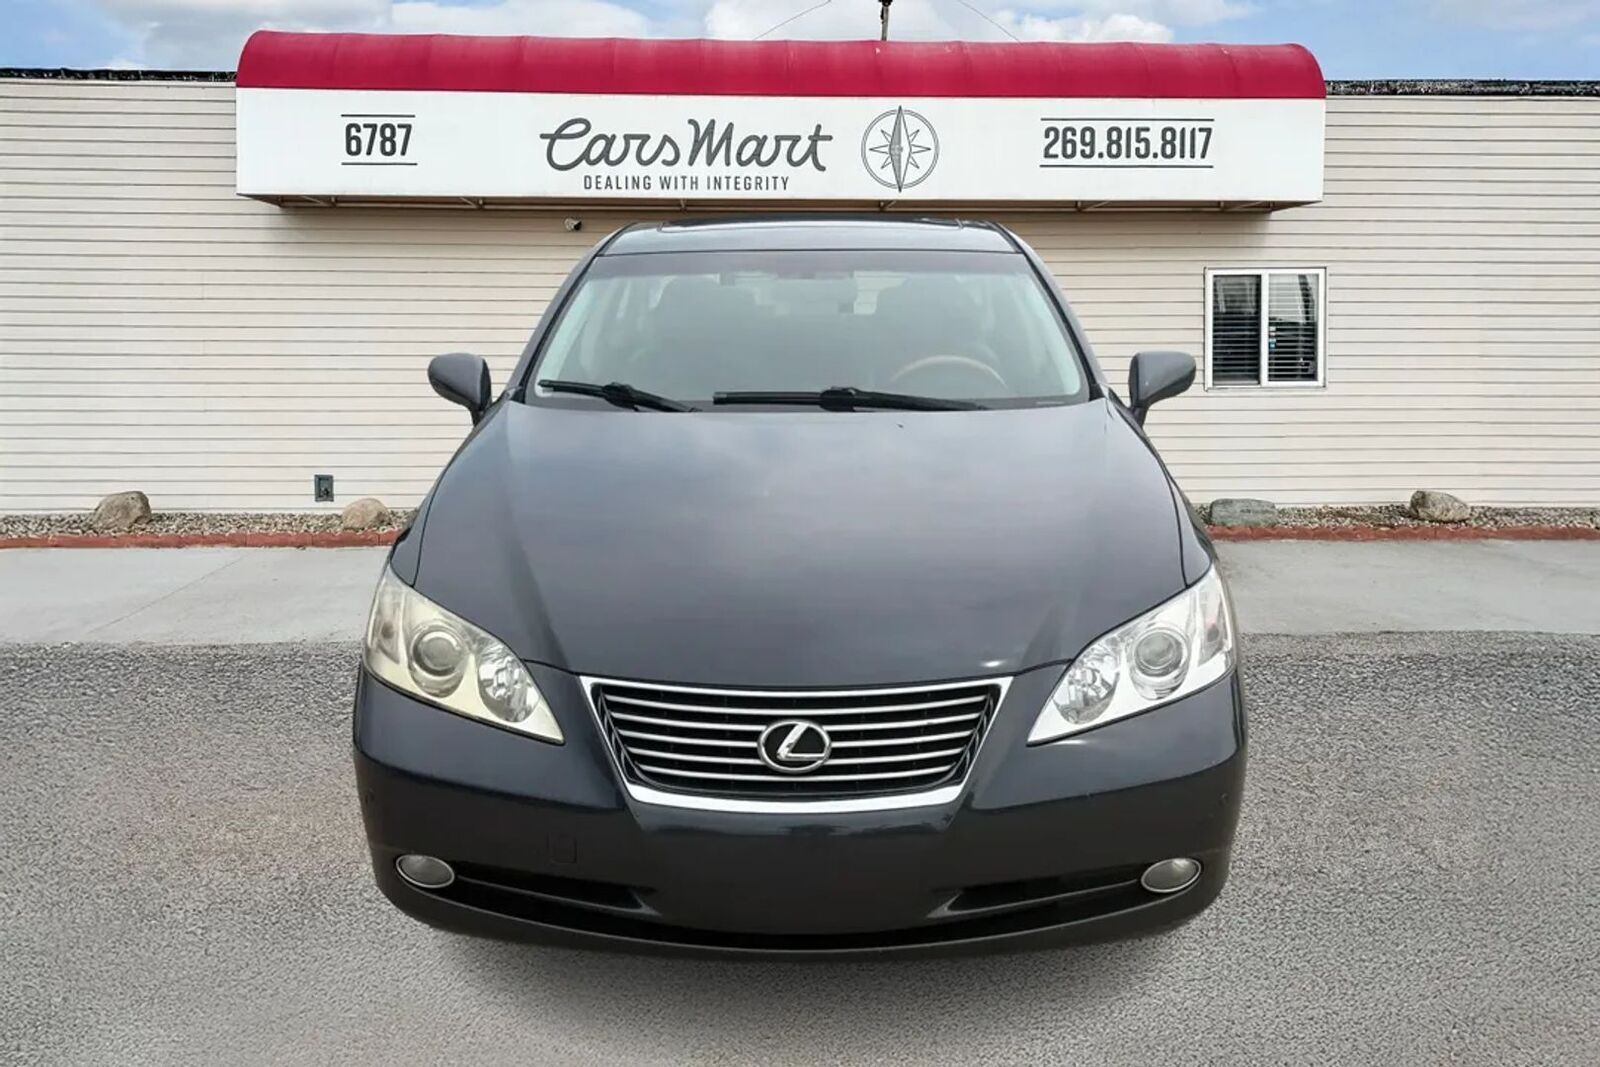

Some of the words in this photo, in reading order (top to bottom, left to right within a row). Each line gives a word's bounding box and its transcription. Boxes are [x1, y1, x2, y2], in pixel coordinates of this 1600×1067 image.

[345, 122, 413, 157] 6787
[1043, 126, 1213, 160] 269.815.8117
[583, 175, 652, 190] DEALING
[659, 176, 699, 190] WITH
[706, 176, 790, 191] INTEGRITY
